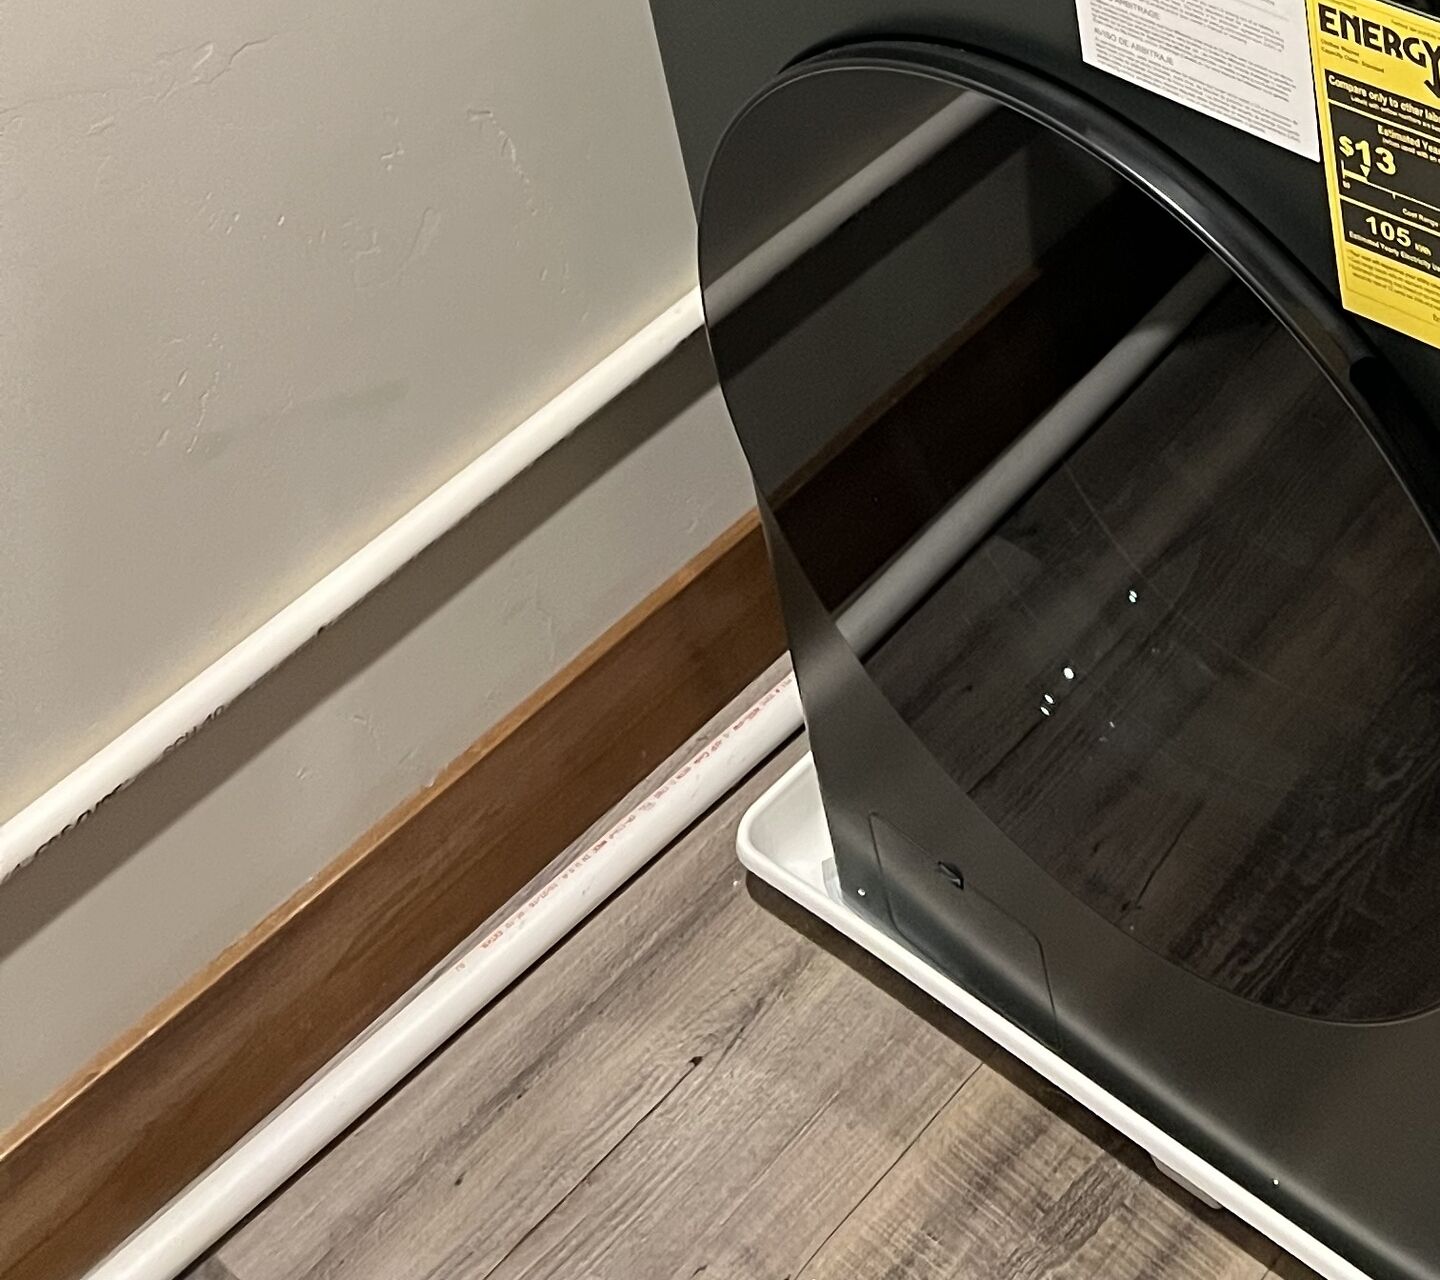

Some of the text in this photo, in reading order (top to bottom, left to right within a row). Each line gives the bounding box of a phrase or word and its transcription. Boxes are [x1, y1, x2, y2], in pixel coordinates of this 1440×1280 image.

[1367, 88, 1388, 107] only
[1388, 96, 1399, 109] to
[1337, 129, 1396, 178] $13
[1365, 212, 1412, 250] 105
